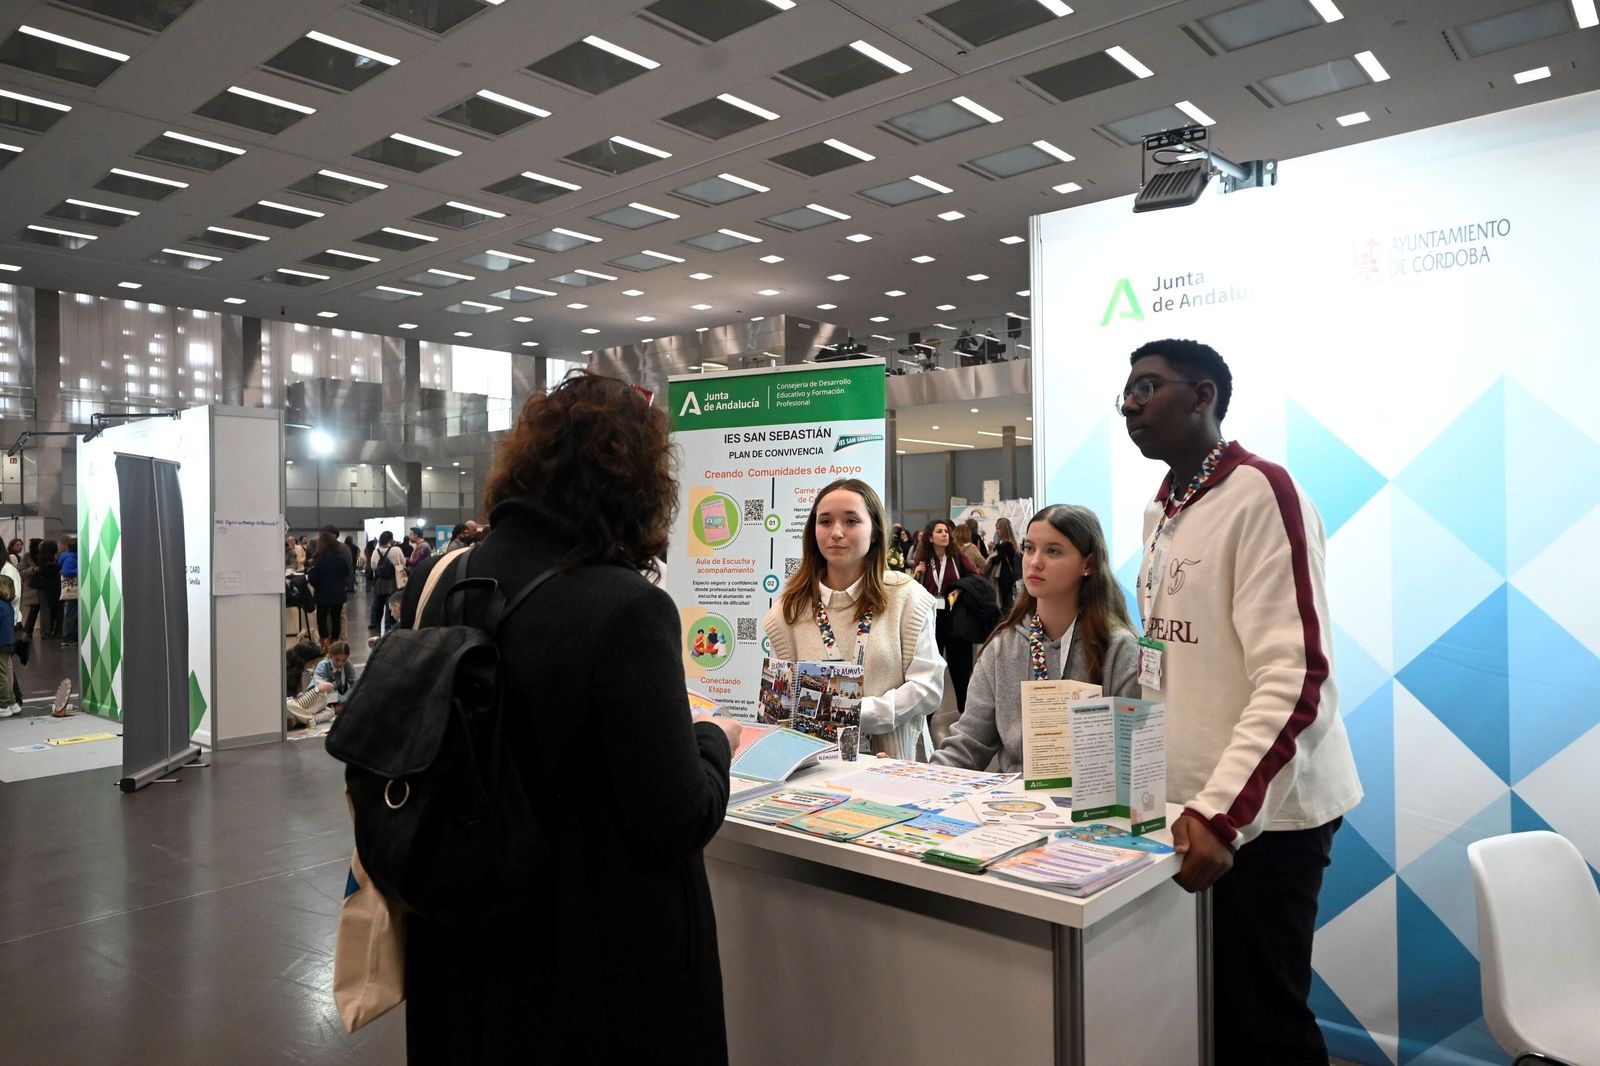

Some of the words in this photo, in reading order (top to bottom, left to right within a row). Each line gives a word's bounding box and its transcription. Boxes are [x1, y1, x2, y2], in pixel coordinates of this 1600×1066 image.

[1391, 218, 1511, 253] AYUNTAMIENTO
[1390, 259, 1408, 277] DE
[1412, 245, 1491, 273] CÓRDOBA
[1152, 272, 1205, 292] Junta
[1152, 297, 1174, 312] de
[818, 378, 851, 387] Desarrollo
[704, 392, 729, 402] Junta
[776, 390, 806, 399] Educativo
[812, 387, 845, 396] Formación
[703, 402, 715, 412] de
[716, 397, 760, 410] Andalucía
[776, 399, 811, 408] Profesional
[724, 433, 741, 444] IES
[743, 431, 766, 443] SAN
[769, 426, 832, 441] SEBASTIÁN
[729, 450, 750, 459] PLAN
[752, 449, 763, 458] DE
[765, 447, 824, 457] CONVIVENCIA
[705, 470, 743, 479] Creando
[748, 467, 812, 477] Comunidades
[814, 466, 827, 475] de
[829, 464, 862, 476] Apoyo
[700, 677, 741, 685] Conectando
